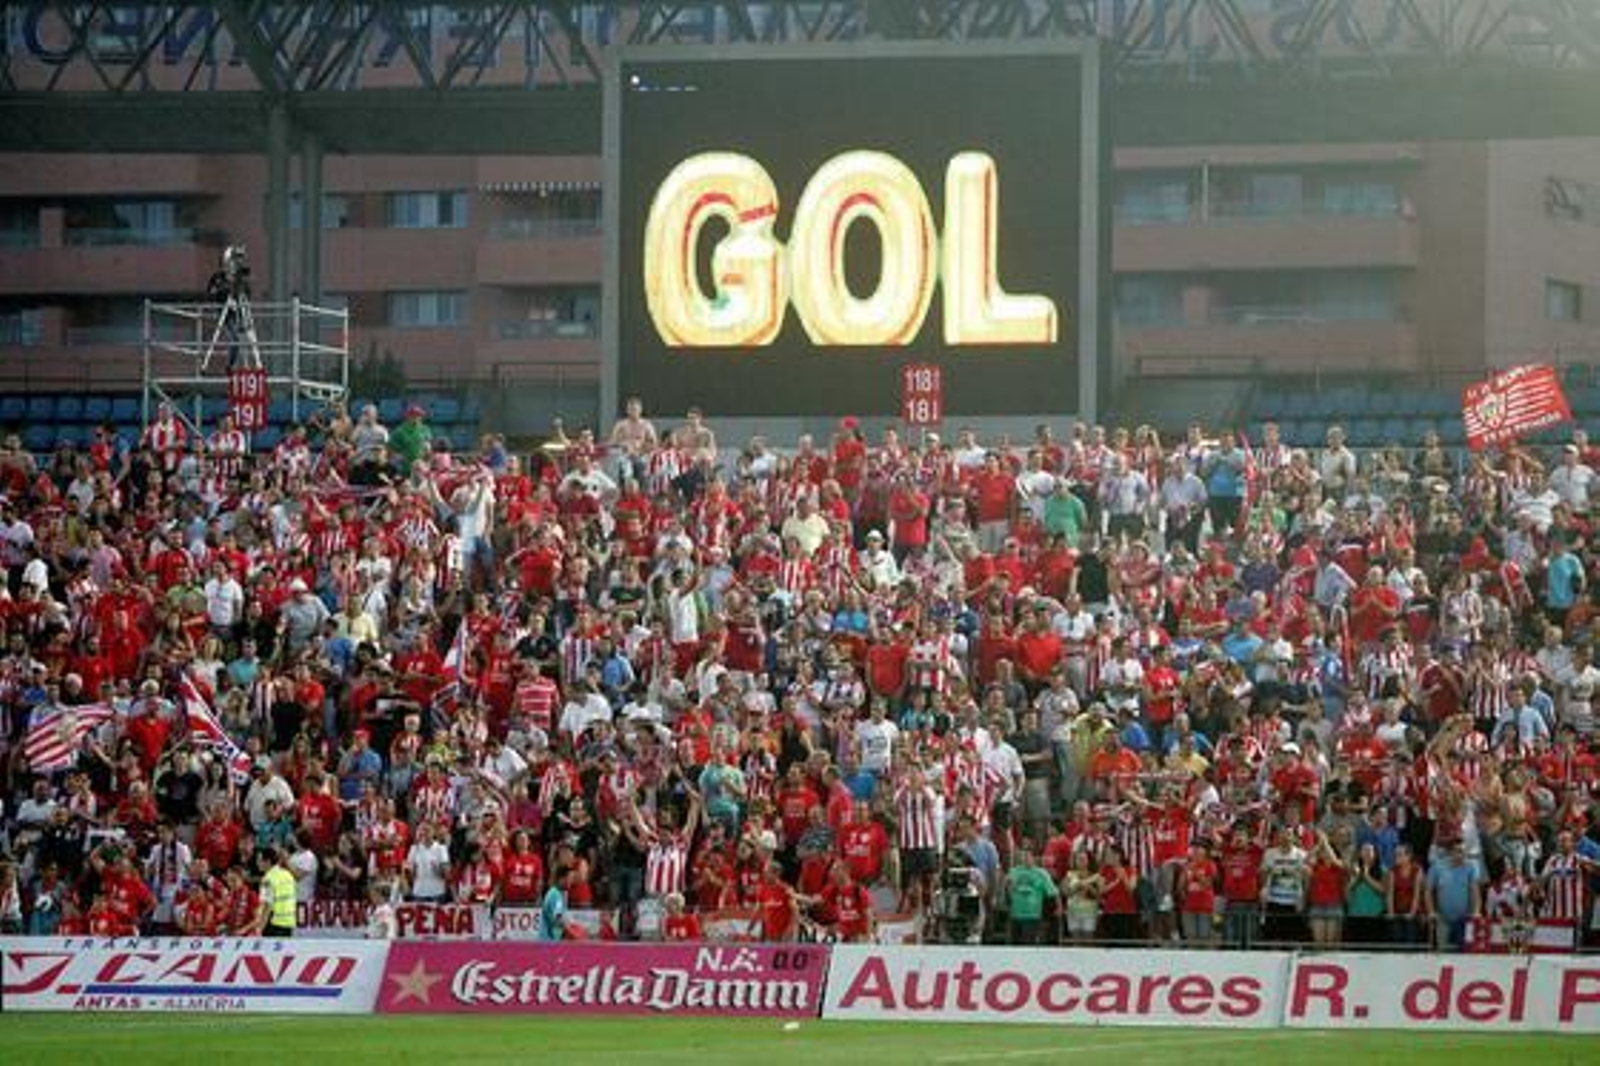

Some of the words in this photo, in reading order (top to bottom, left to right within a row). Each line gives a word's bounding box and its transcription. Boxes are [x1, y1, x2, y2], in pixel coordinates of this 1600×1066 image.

[643, 149, 1058, 348] GOL
[64, 937, 284, 951] TRANSPORTES
[95, 953, 358, 985] CANO
[73, 996, 141, 1009] ANTAS
[452, 959, 645, 1004] Estrella
[645, 967, 810, 1010] Damm
[838, 956, 1263, 1018] Autocares
[1290, 963, 1369, 1018] R.
[1402, 965, 1529, 1022] del
